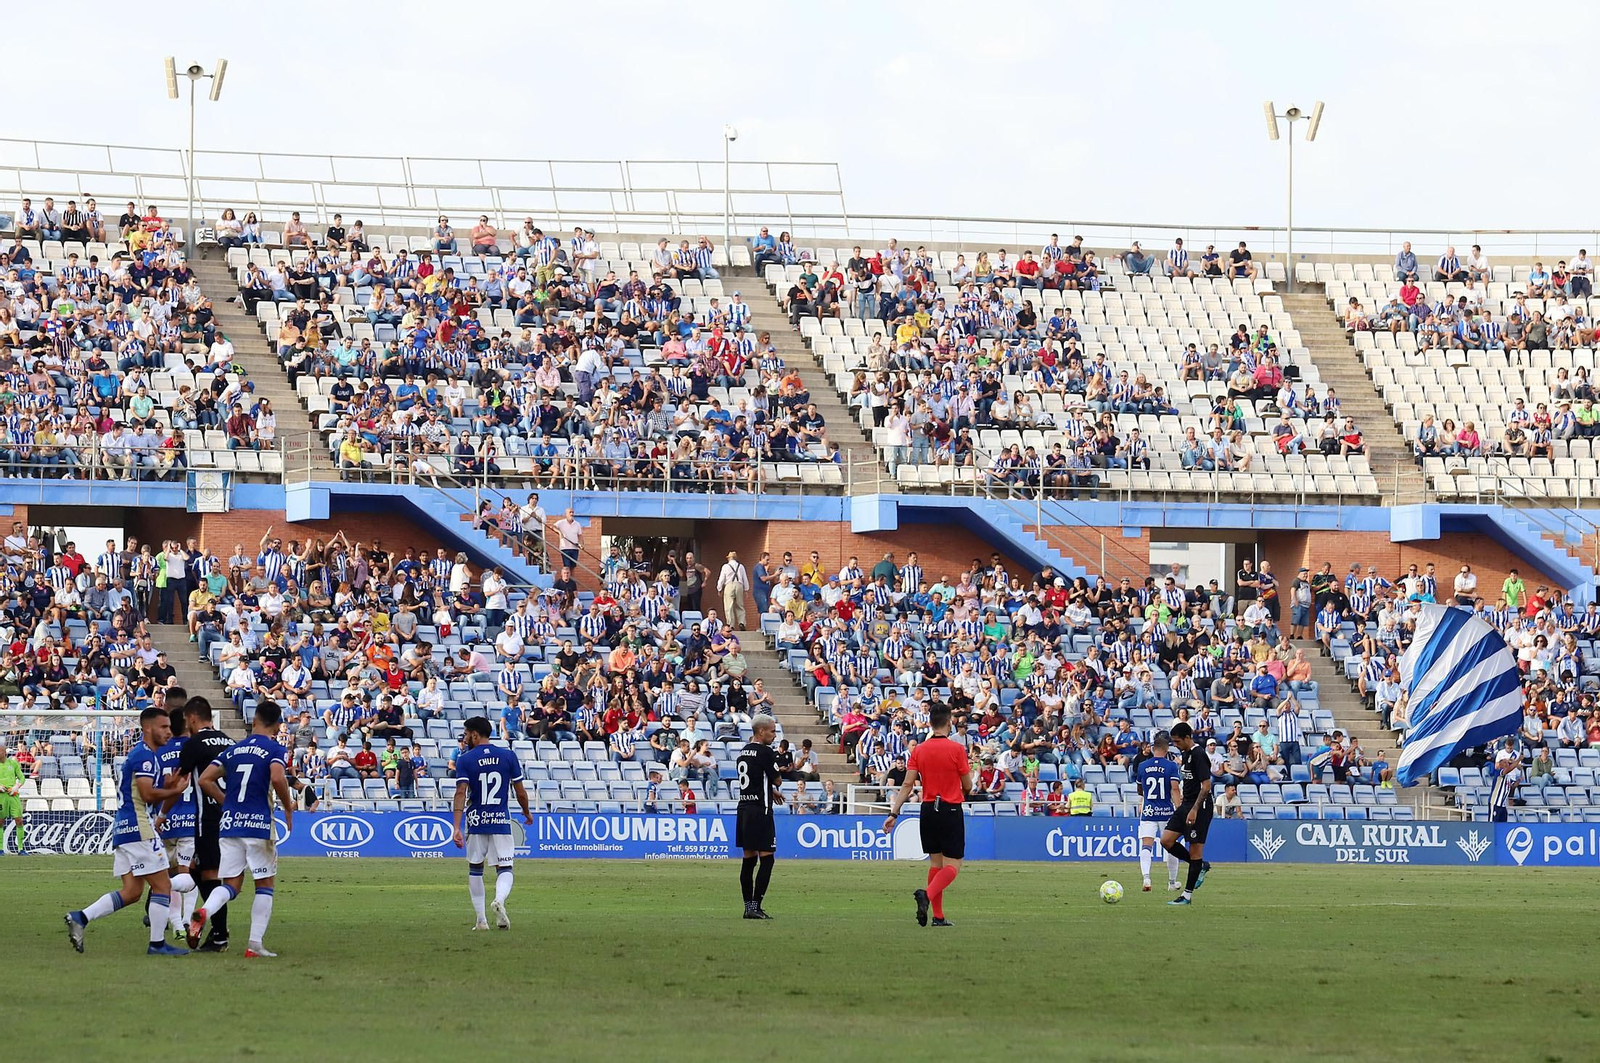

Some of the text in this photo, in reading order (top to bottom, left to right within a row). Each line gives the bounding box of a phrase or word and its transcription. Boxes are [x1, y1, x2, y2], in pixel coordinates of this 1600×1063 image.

[161, 750, 181, 762] GUST
[233, 745, 269, 759] MARTÍNEZ
[478, 757, 500, 767] CHULI
[737, 760, 750, 791] 8
[236, 763, 254, 803] 7
[478, 771, 502, 806] 12
[1145, 776, 1166, 800] 21
[171, 813, 186, 821] Que
[234, 812, 250, 820] Que
[481, 810, 494, 819] Que
[233, 820, 271, 830] de Huelva
[322, 823, 363, 841] KIA
[538, 817, 728, 842] INMOUMBRIA
[405, 824, 445, 842] KIA
[797, 821, 891, 848] Onuba
[1296, 823, 1447, 848] CAJA RURAL
[539, 843, 624, 851] Servicios Inmobiliarios
[667, 845, 729, 853] Telf. 959 87 92 72
[1544, 828, 1600, 862] pal
[411, 851, 443, 859] VEYSER
[851, 850, 892, 860] FRUIT
[1336, 848, 1410, 863] DEL SUR
